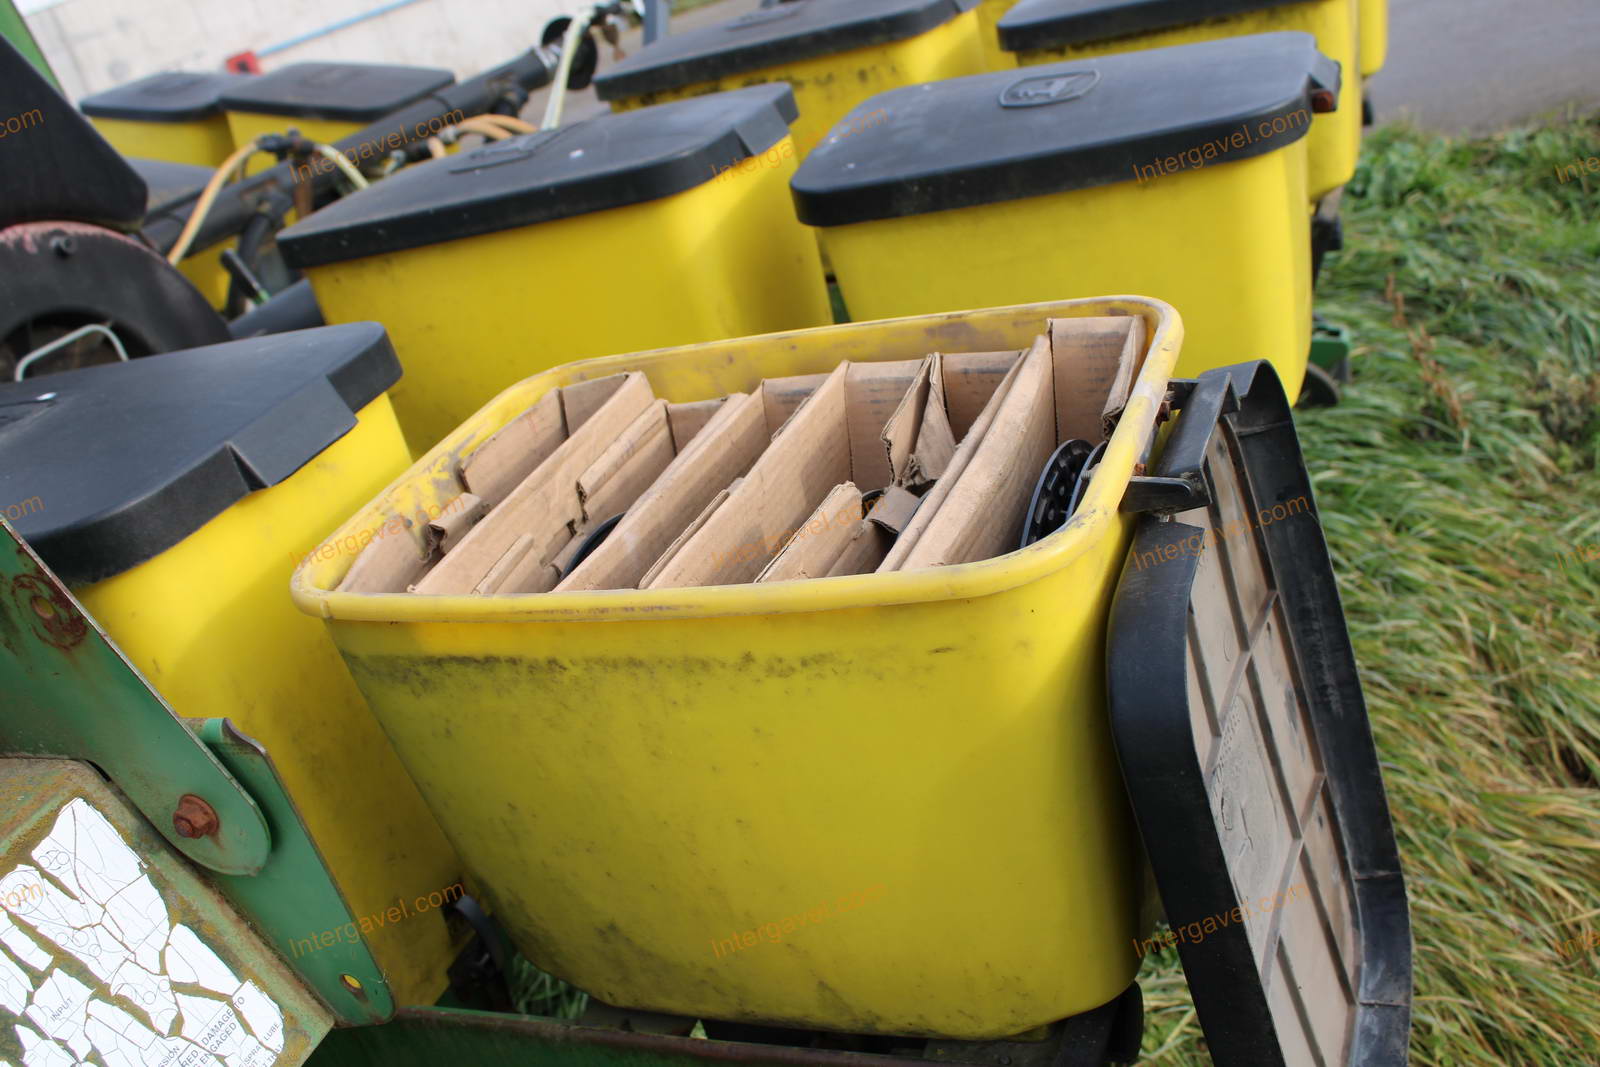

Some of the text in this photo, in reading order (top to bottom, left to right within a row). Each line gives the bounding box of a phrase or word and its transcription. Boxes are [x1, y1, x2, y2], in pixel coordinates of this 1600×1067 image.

[50, 997, 73, 1022] INPUT
[201, 1008, 234, 1046] DAMAGE
[233, 996, 245, 1009] TO
